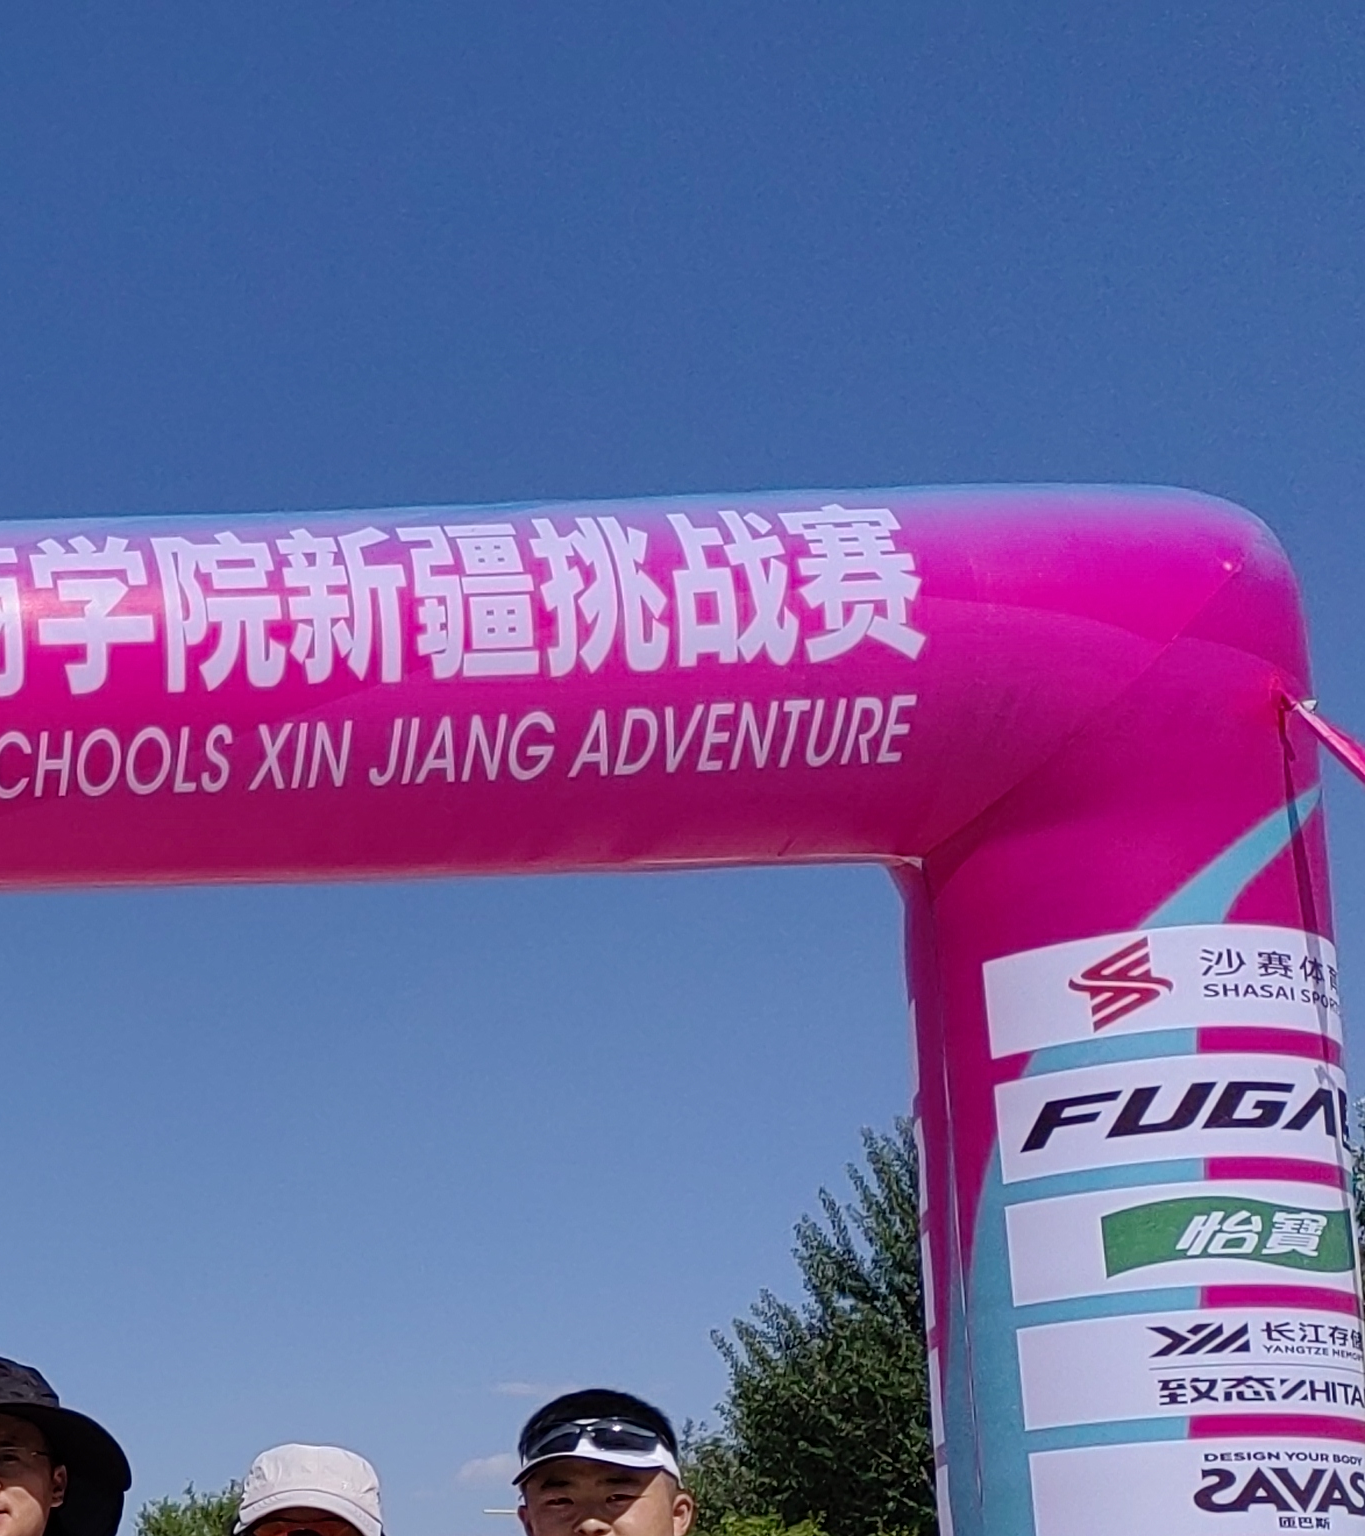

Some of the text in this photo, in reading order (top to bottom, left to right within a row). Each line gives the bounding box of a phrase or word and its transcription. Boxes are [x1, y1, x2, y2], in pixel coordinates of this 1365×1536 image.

[250, 718, 351, 791] XIN
[369, 711, 555, 787] JIANG
[570, 693, 918, 779] ADVENTURE
[1203, 983, 1296, 1002] SHASAI
[1175, 1210, 1328, 1258] 怡寶
[1262, 1345, 1330, 1357] YANGTZE
[1203, 1452, 1363, 1467] DESIGN YOUR BODY
